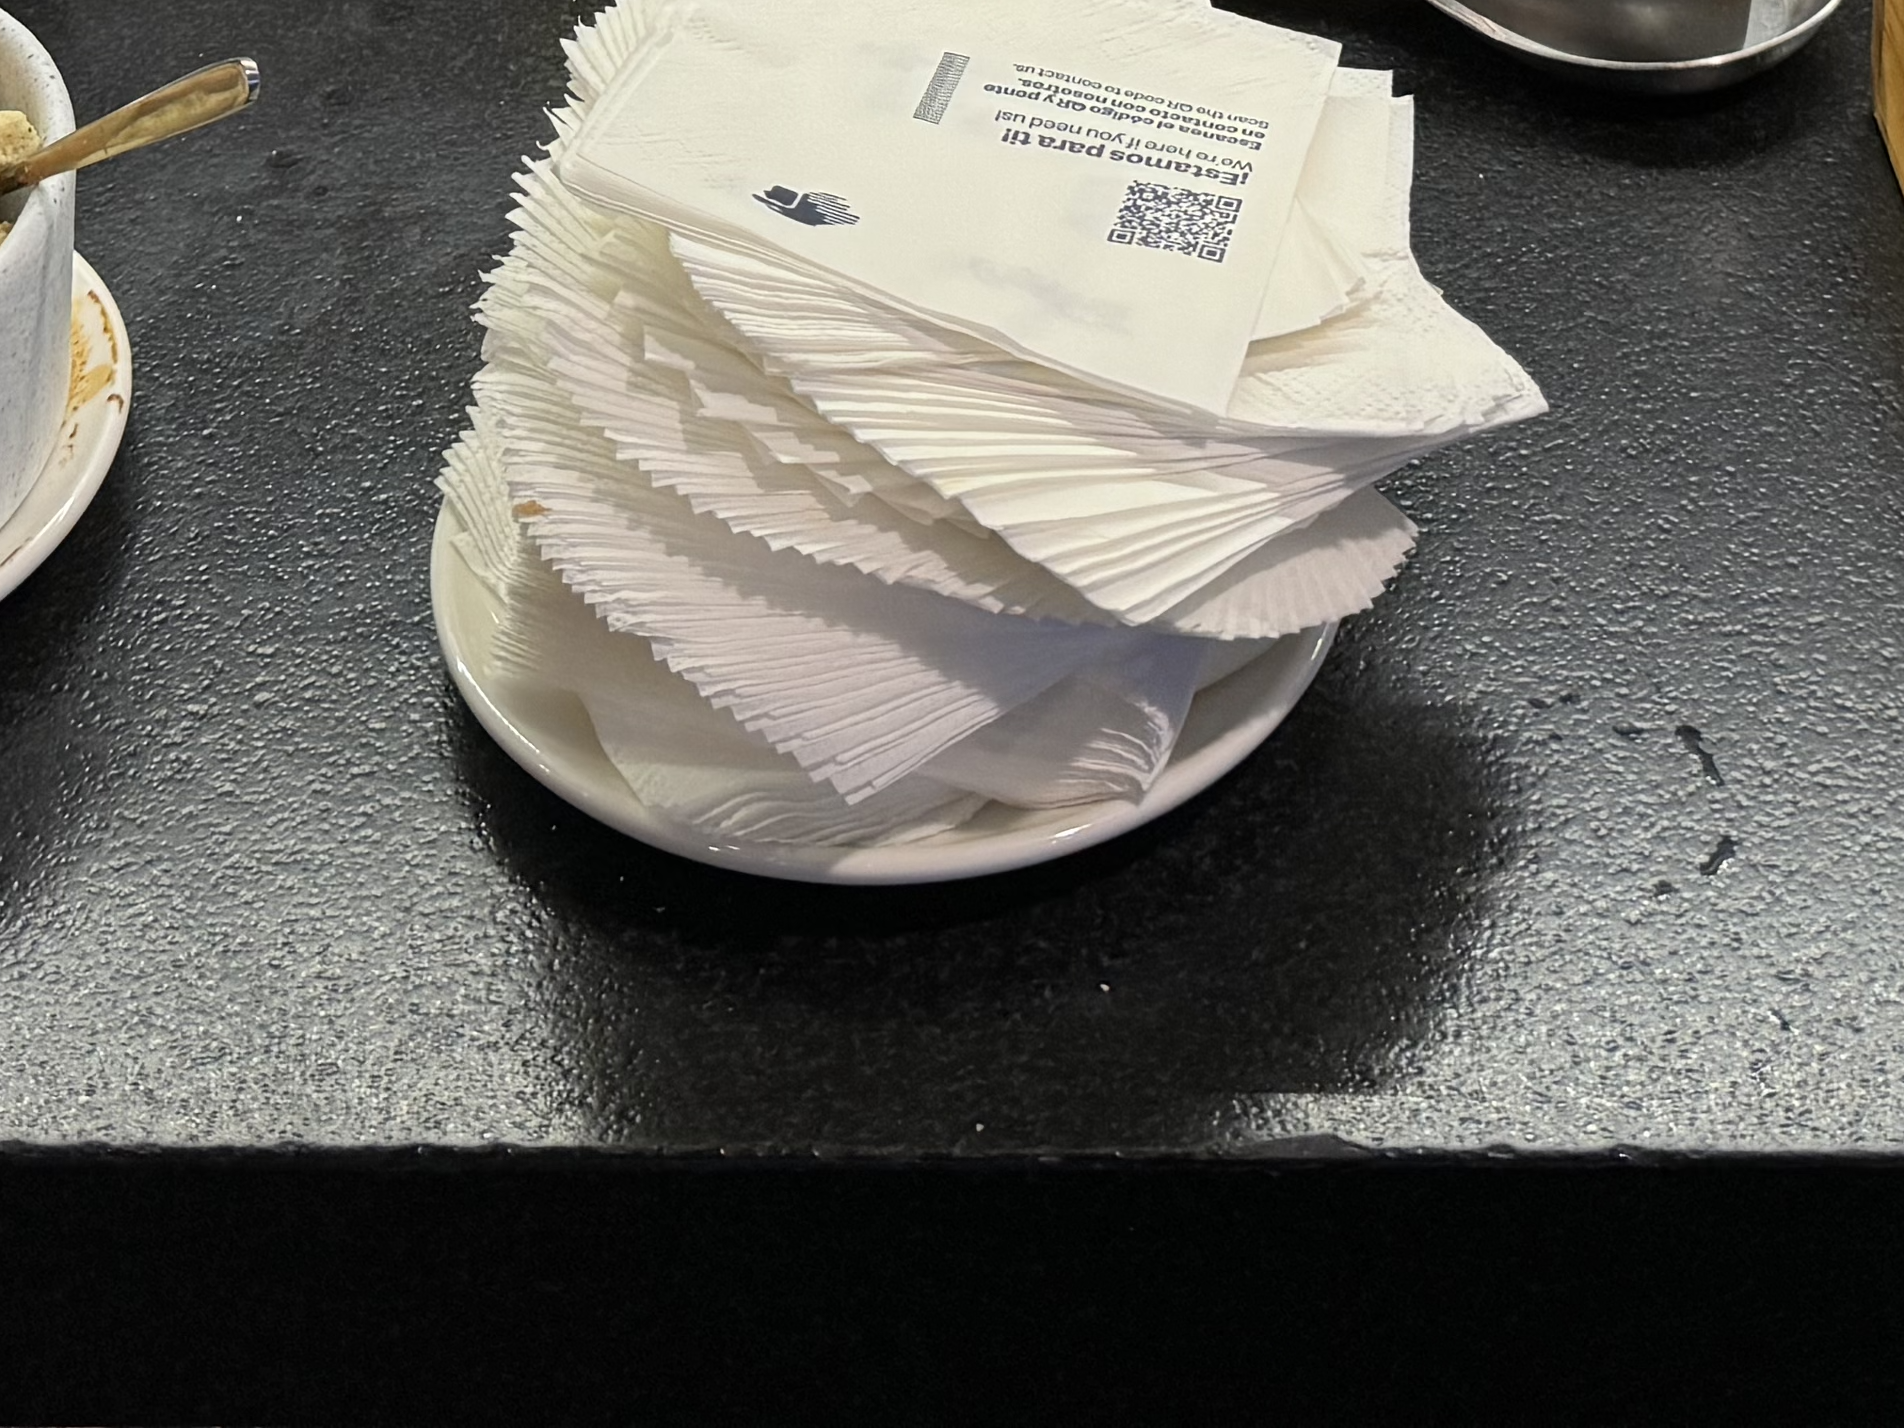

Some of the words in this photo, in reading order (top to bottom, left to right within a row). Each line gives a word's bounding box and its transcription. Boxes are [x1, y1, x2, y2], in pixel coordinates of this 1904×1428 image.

[1034, 68, 1102, 90] contact
[983, 84, 1041, 101] ponte
[1017, 78, 1107, 104] nosotros.
[1043, 93, 1056, 103] y
[1105, 86, 1121, 96] to
[1124, 90, 1165, 104] code
[1056, 98, 1086, 112] QR
[1111, 99, 1146, 113] con
[1166, 100, 1193, 112] QR
[1196, 107, 1224, 119] the
[995, 110, 1026, 124] us!
[1090, 106, 1154, 125] código
[1149, 108, 1238, 133] contacto
[1227, 114, 1269, 129] Scan
[1029, 117, 1082, 135] need
[1157, 121, 1175, 129] el
[1001, 128, 1031, 145] ti!
[1086, 128, 1126, 144] you
[1178, 125, 1262, 151] Escanea
[1242, 129, 1265, 139] en
[1038, 134, 1105, 158] para
[1125, 138, 1141, 150] if
[1145, 141, 1192, 159] here
[1109, 150, 1249, 186] ¡Estamos
[1196, 152, 1253, 172] We're
